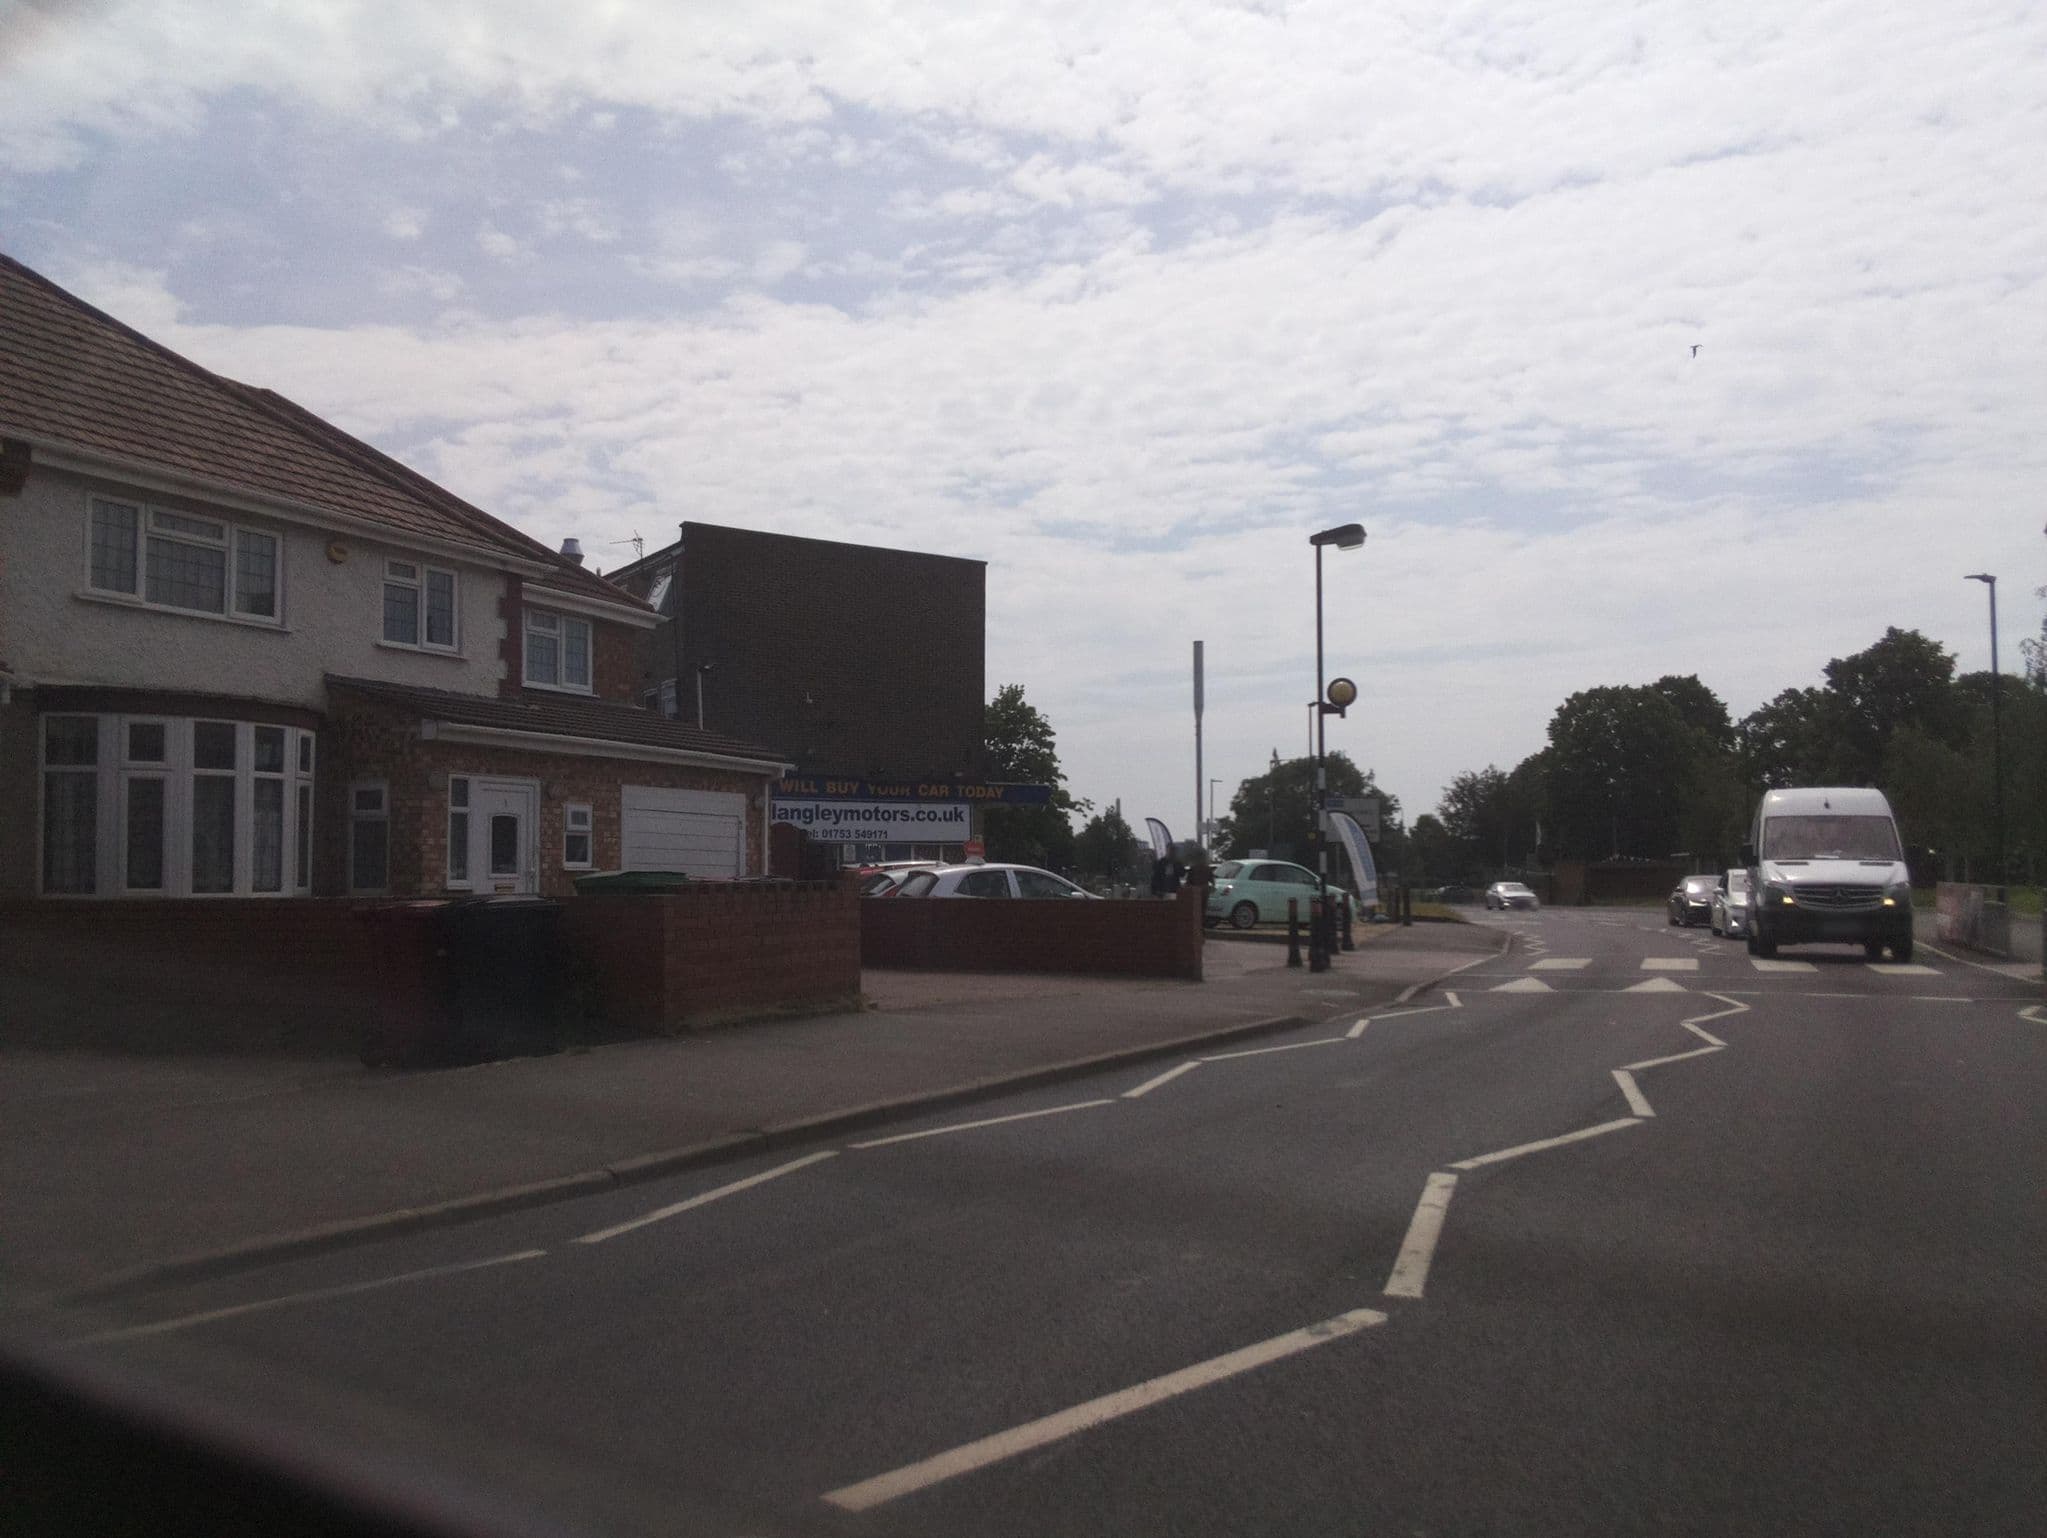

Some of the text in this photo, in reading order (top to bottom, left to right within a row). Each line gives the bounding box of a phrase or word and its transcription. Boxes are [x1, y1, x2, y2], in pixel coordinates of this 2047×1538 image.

[780, 779, 1004, 799] WILL BUY YOUR CAR TODAY
[772, 804, 964, 824] langleymotors.co.uk
[821, 829, 852, 839] 01753
[854, 830, 889, 840] 549171
